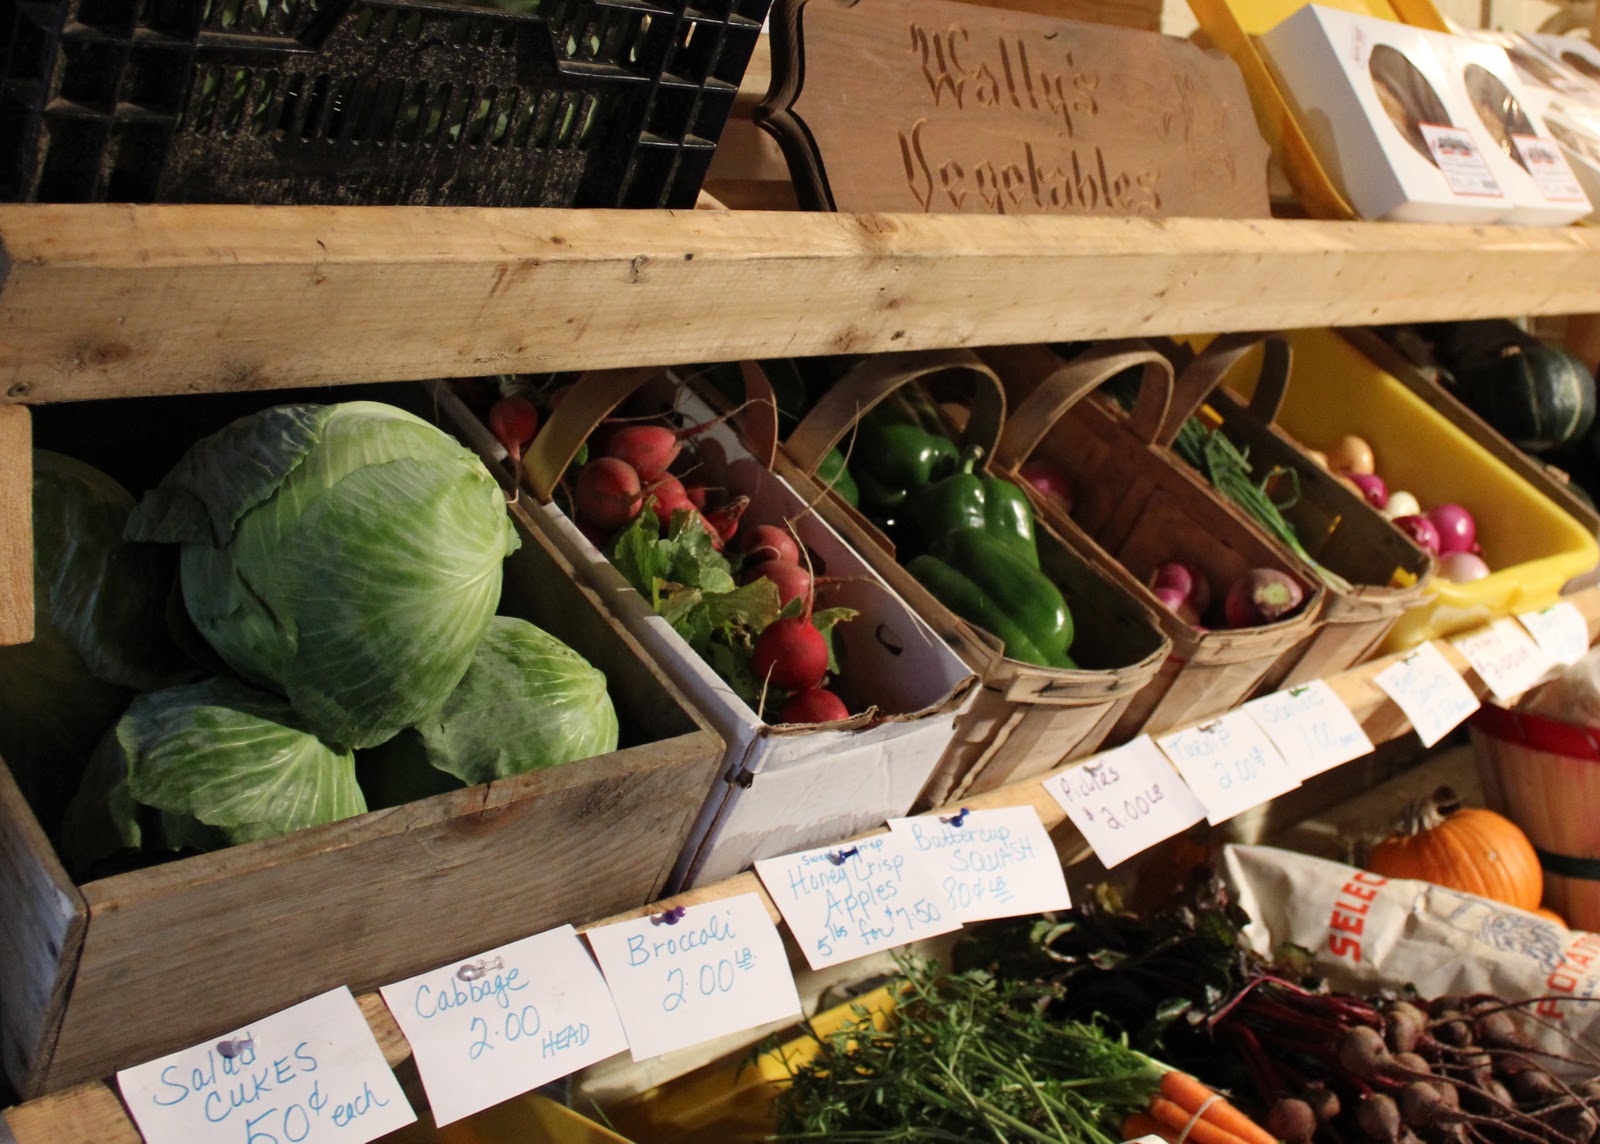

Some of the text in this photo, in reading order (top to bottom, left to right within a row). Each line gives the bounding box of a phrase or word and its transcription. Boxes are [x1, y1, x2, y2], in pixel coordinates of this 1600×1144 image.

[909, 22, 1098, 138] Wally's
[898, 117, 1161, 214] Vegetables
[912, 824, 1009, 851] Buttercup
[788, 865, 853, 901] Honey
[825, 880, 897, 928] Apples
[627, 911, 735, 966] Broccoli
[416, 968, 529, 1018] Cabbage
[663, 960, 734, 1012] 2.00
[469, 1005, 590, 1060] 2.00 HEAD
[153, 1032, 255, 1106] Salad
[331, 1082, 389, 1127] each
